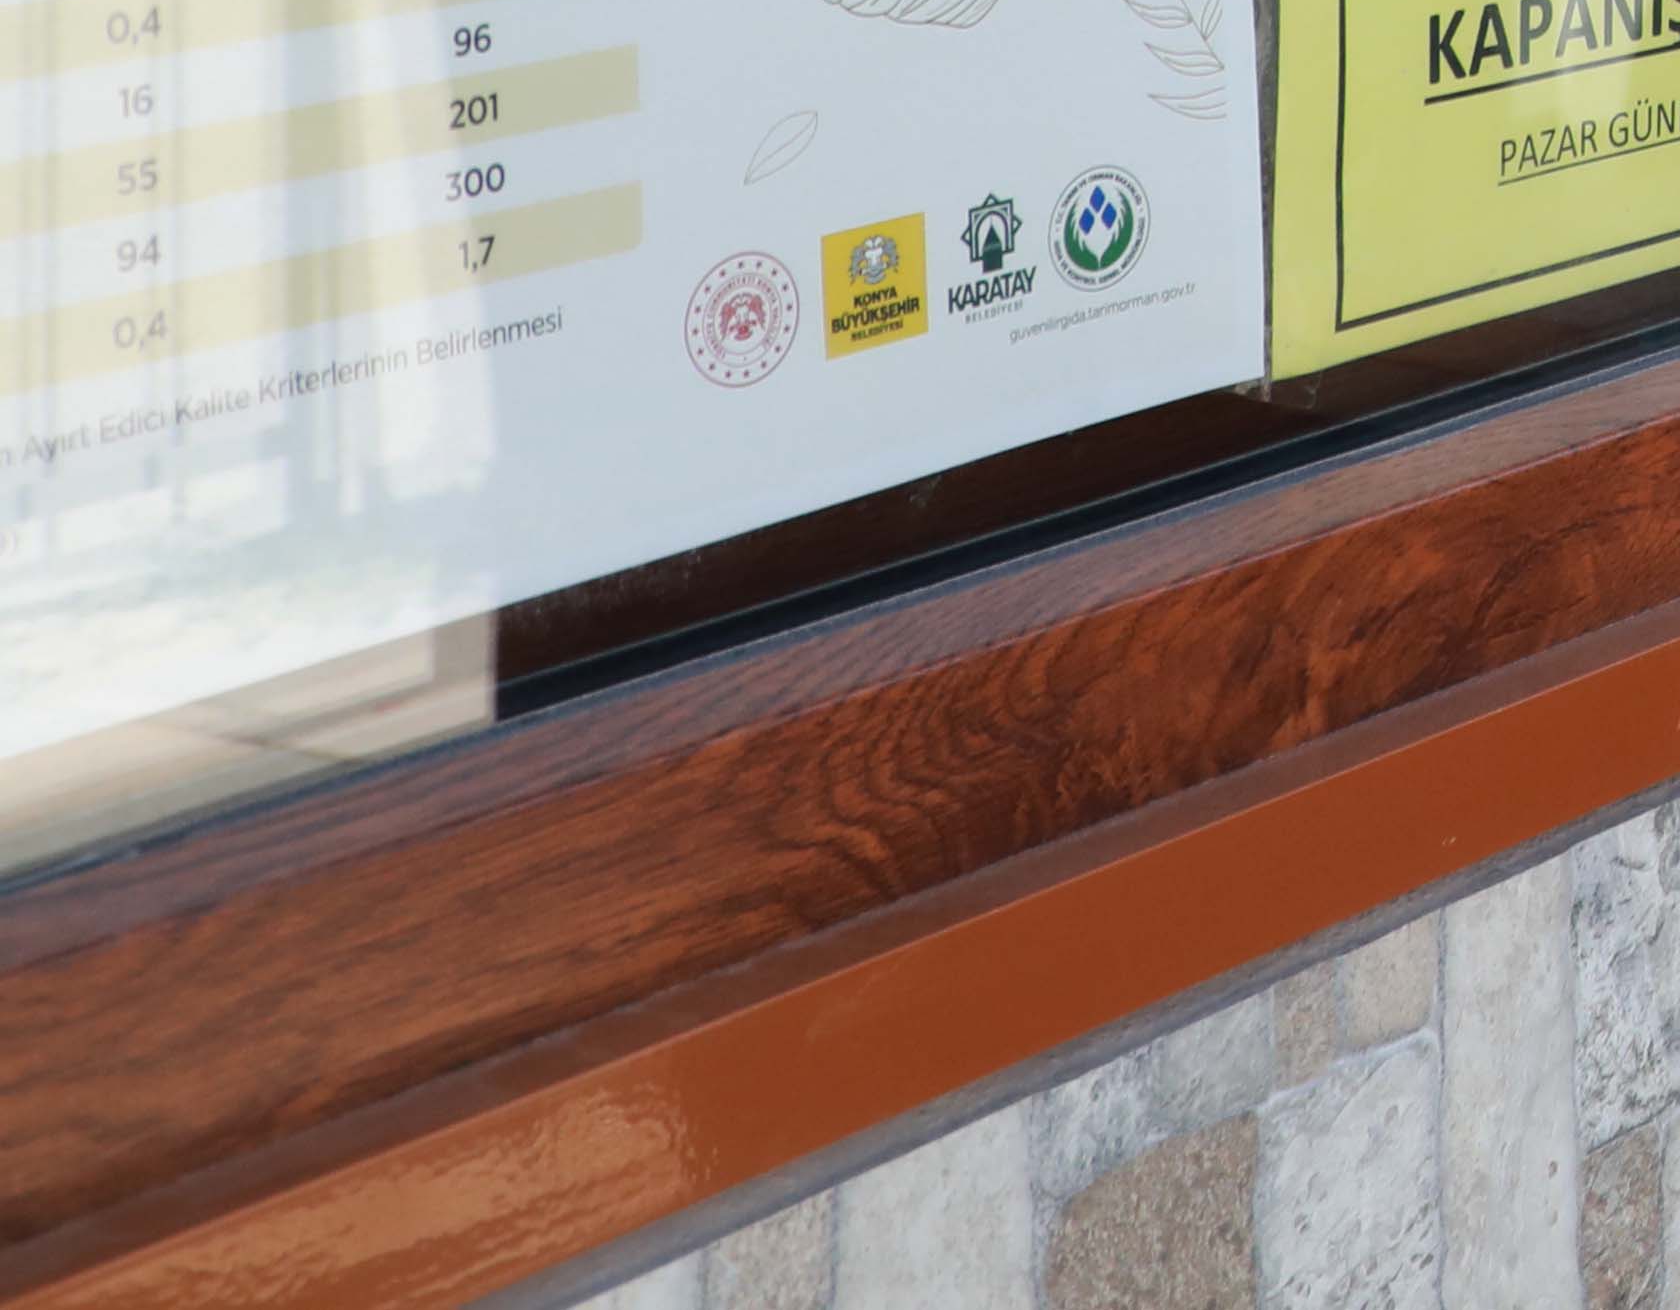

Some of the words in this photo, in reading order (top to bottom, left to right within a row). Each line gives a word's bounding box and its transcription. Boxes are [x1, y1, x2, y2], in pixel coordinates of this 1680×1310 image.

[106, 8, 162, 48] 0,4
[119, 85, 155, 119] 16
[453, 23, 492, 58] 96
[117, 159, 159, 197] 55
[449, 94, 500, 131] 201
[1499, 119, 1599, 178] PAZAR
[116, 235, 162, 273] 94
[445, 163, 506, 203] 300
[112, 309, 169, 353] 0,4
[458, 236, 497, 274] 1,7
[831, 295, 920, 334] BÜYÜKŞEHİR
[853, 286, 898, 309] KONYA
[948, 266, 1037, 315] KARATAY
[22, 423, 92, 464] Ayırt
[98, 407, 166, 446] Edici
[174, 388, 251, 425] Kalite
[258, 348, 409, 406] Kriterlerinin
[415, 305, 564, 366] Belirlenmesi
